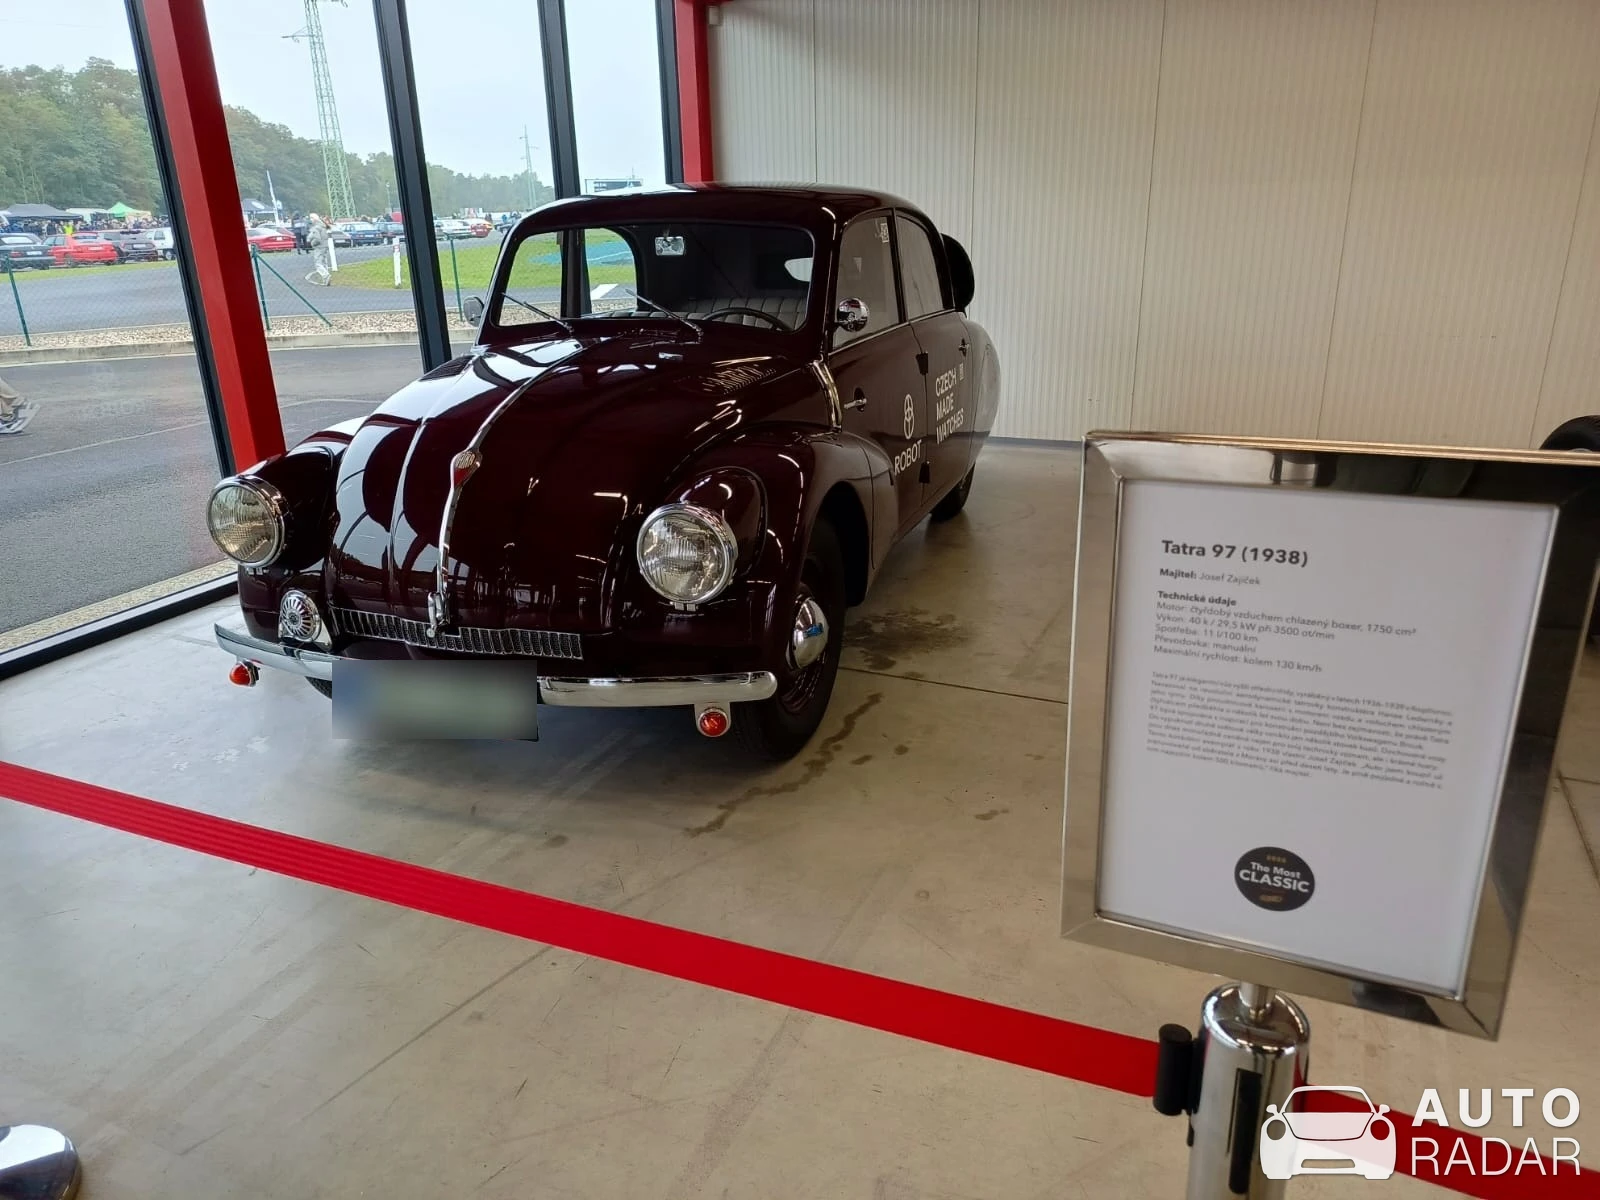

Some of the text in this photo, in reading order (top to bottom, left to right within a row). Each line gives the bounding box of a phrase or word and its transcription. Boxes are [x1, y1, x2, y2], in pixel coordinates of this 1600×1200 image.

[935, 367, 957, 397] CZECH
[936, 392, 954, 422] MADE
[936, 408, 964, 445] WATCHES
[894, 439, 922, 476] ROBOT
[1161, 540, 1309, 568] Tatra 97 (1938)
[1159, 568, 1197, 580] Majitel:
[1199, 572, 1225, 583] Josef
[1157, 590, 1237, 608] Technické údaje
[1189, 616, 1201, 626] 40
[1239, 621, 1257, 632] kW
[1273, 625, 1300, 636] 3500
[1233, 611, 1283, 623] vzduchem
[1285, 616, 1329, 630] chlazený
[1368, 623, 1393, 635] 1750
[1243, 633, 1259, 642] km
[1243, 656, 1273, 667] kolem
[1276, 659, 1295, 671] 130
[1296, 661, 1323, 673] km/h
[1239, 869, 1310, 893] CLASSIC
[1250, 861, 1302, 879] The Most
